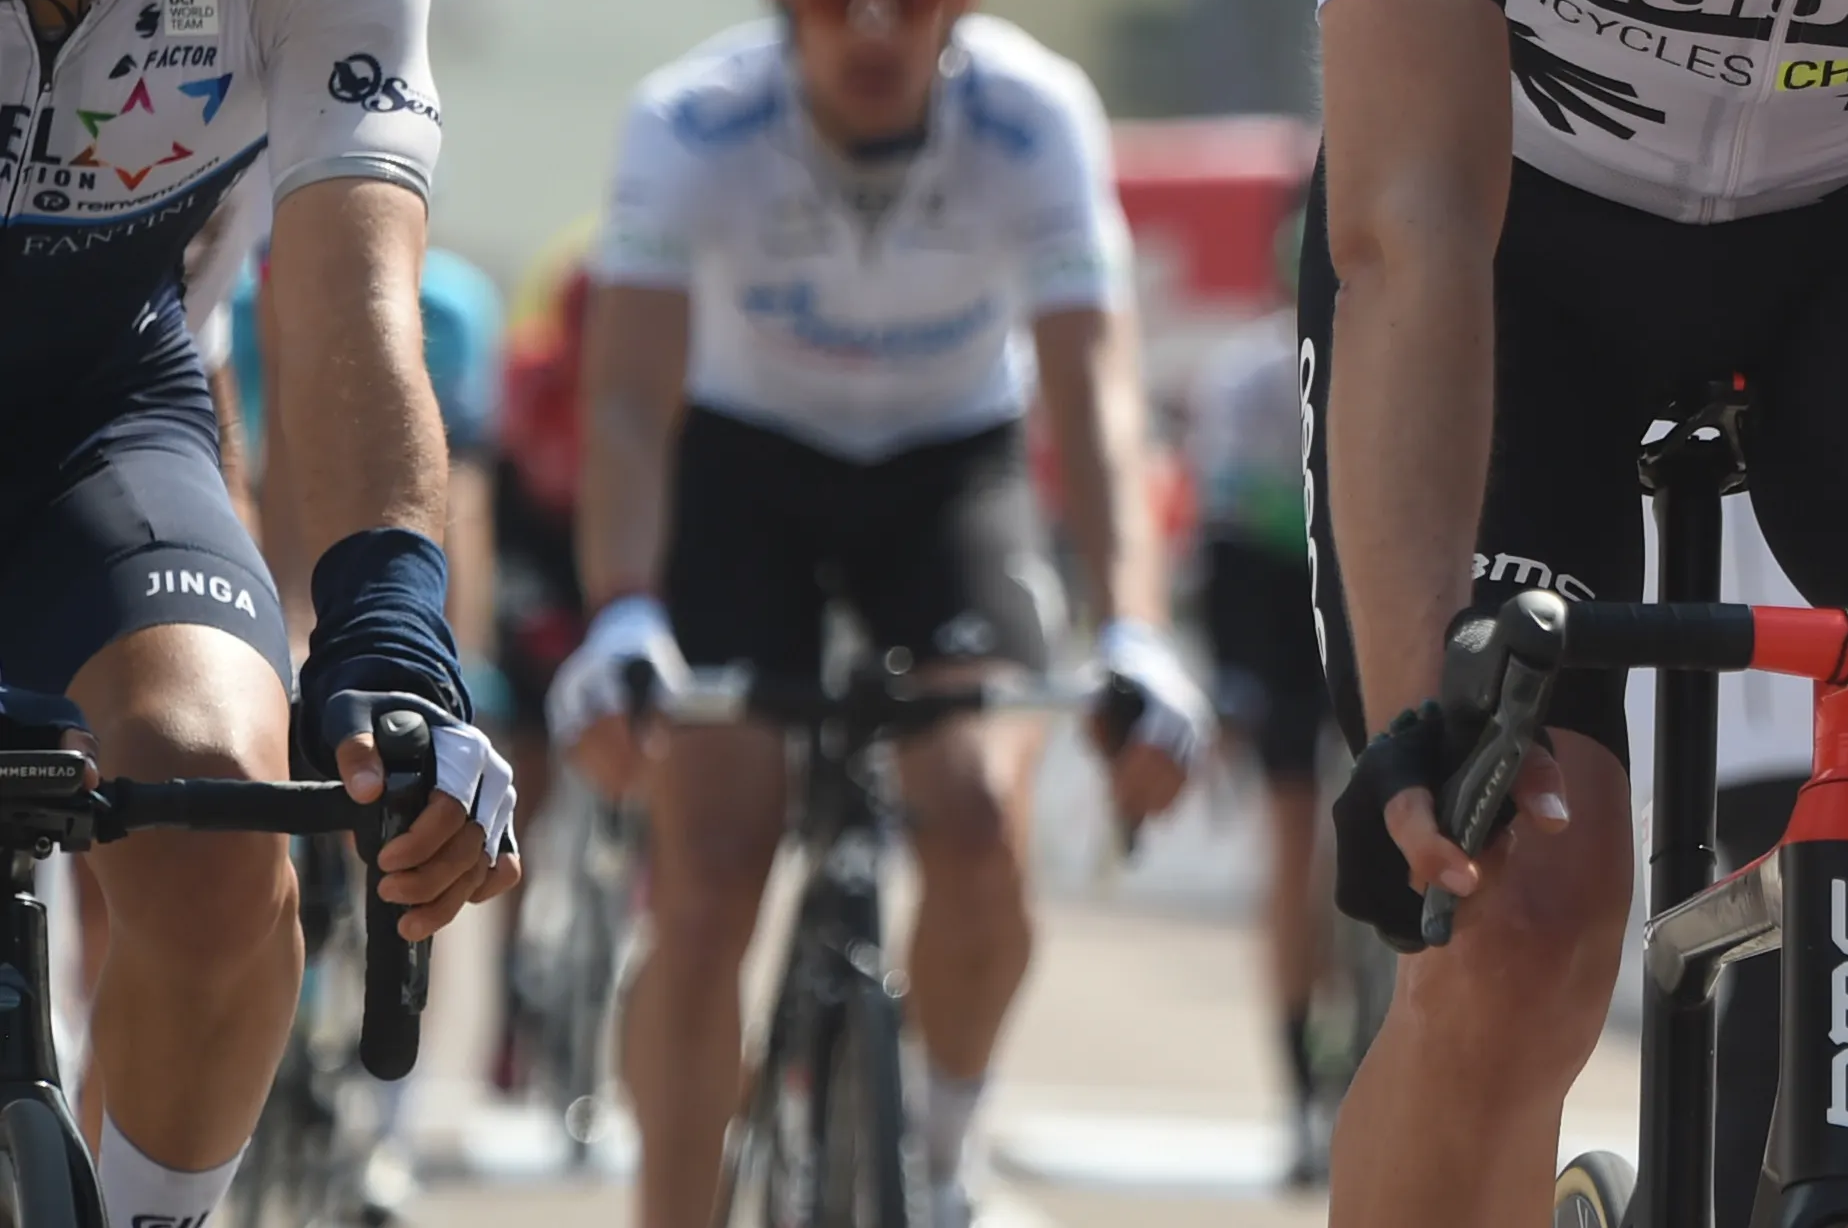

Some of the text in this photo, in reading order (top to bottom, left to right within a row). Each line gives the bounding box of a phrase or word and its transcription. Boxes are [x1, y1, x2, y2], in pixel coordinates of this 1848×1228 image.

[170, 5, 215, 18] WORLD
[171, 18, 203, 31] TEAM
[143, 44, 218, 71] FACTOR
[22, 193, 195, 256] FANTINI
[145, 569, 257, 619] JINGA
